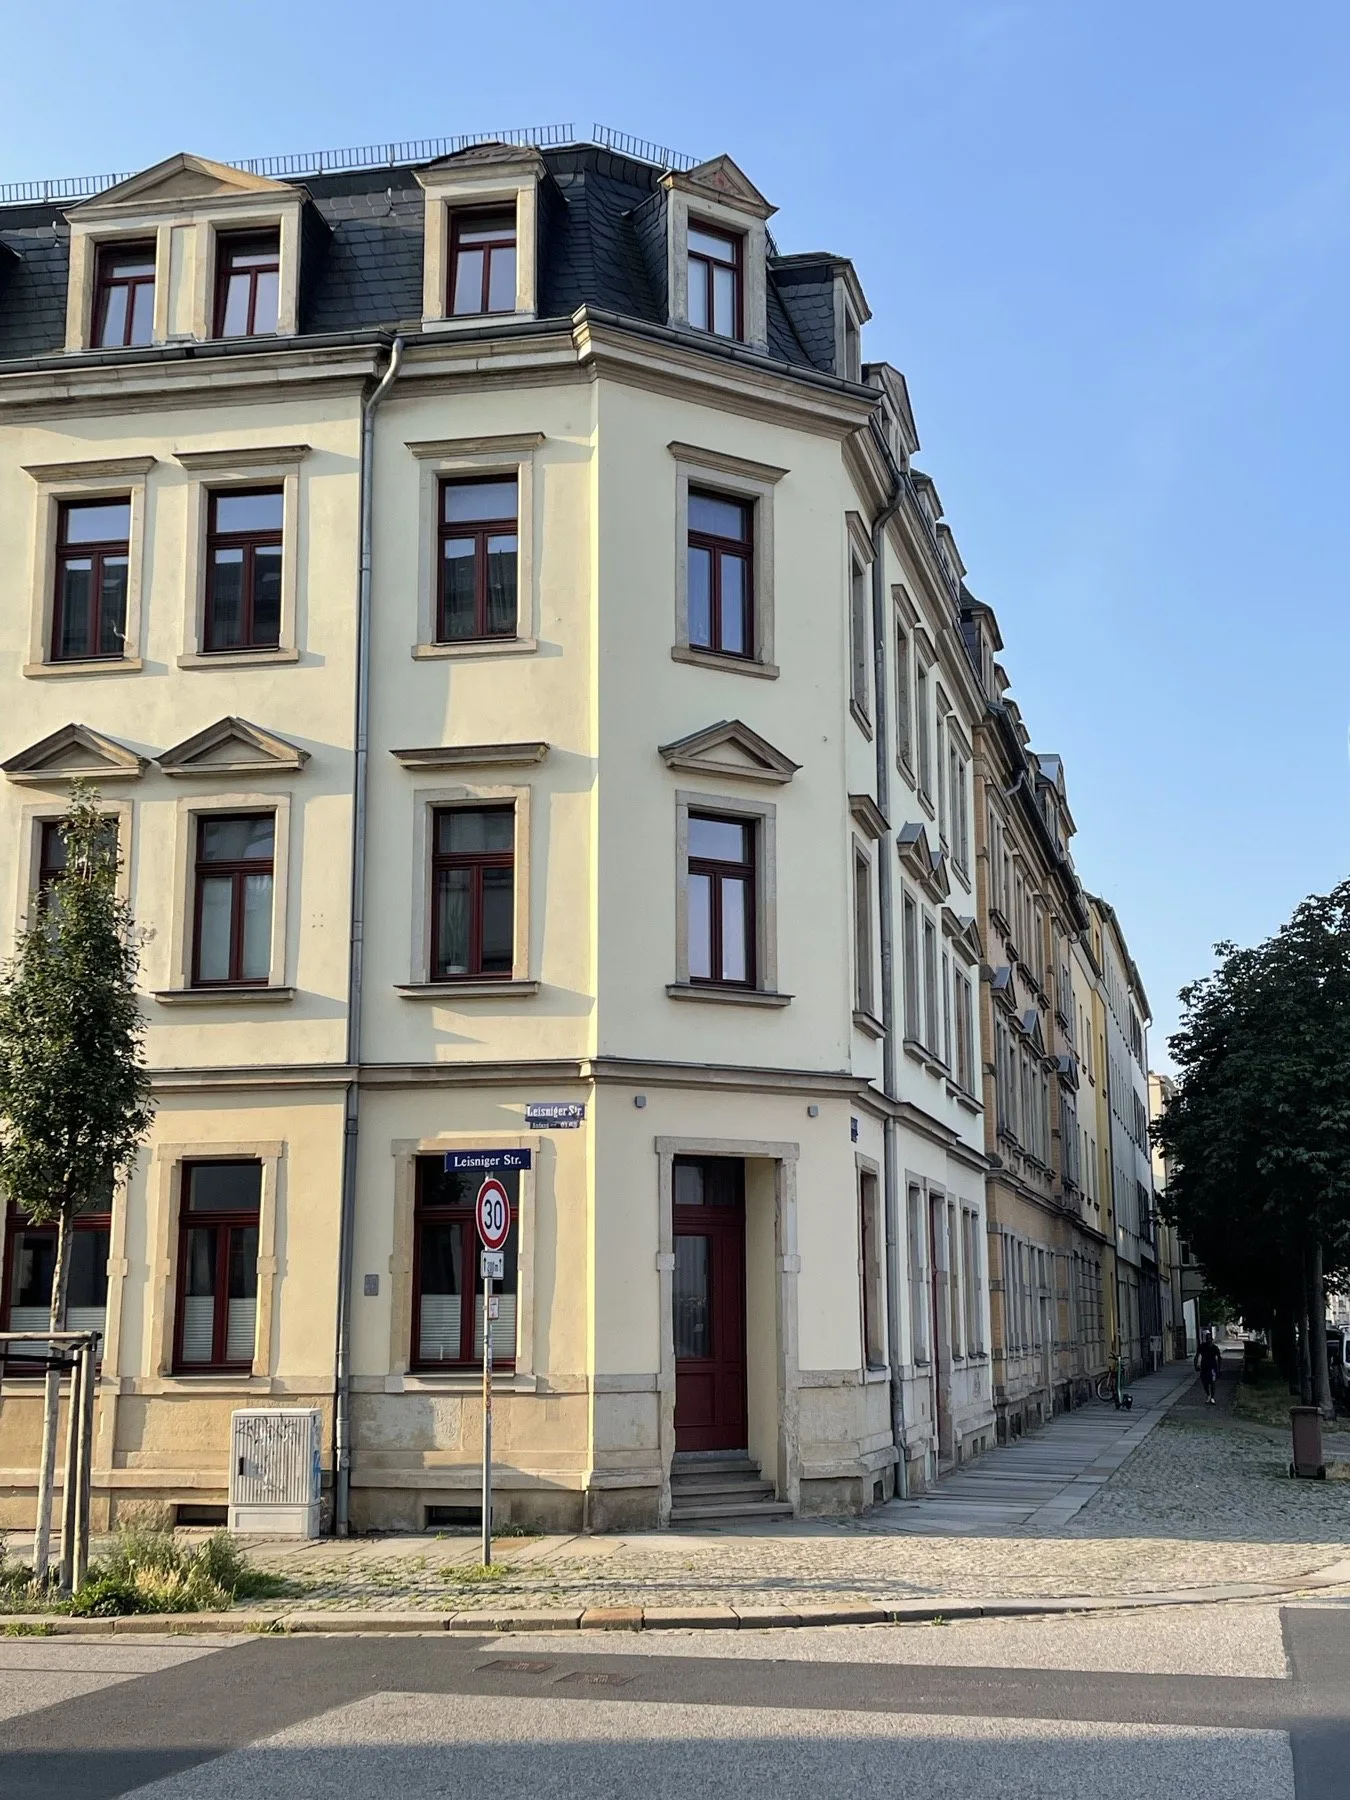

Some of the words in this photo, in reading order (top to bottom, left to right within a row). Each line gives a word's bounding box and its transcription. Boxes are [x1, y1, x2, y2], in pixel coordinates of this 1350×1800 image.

[527, 1105, 567, 1118] Leisniger
[454, 1155, 500, 1168] Leisniger
[503, 1154, 522, 1166] Str.
[484, 1199, 502, 1230] 30
